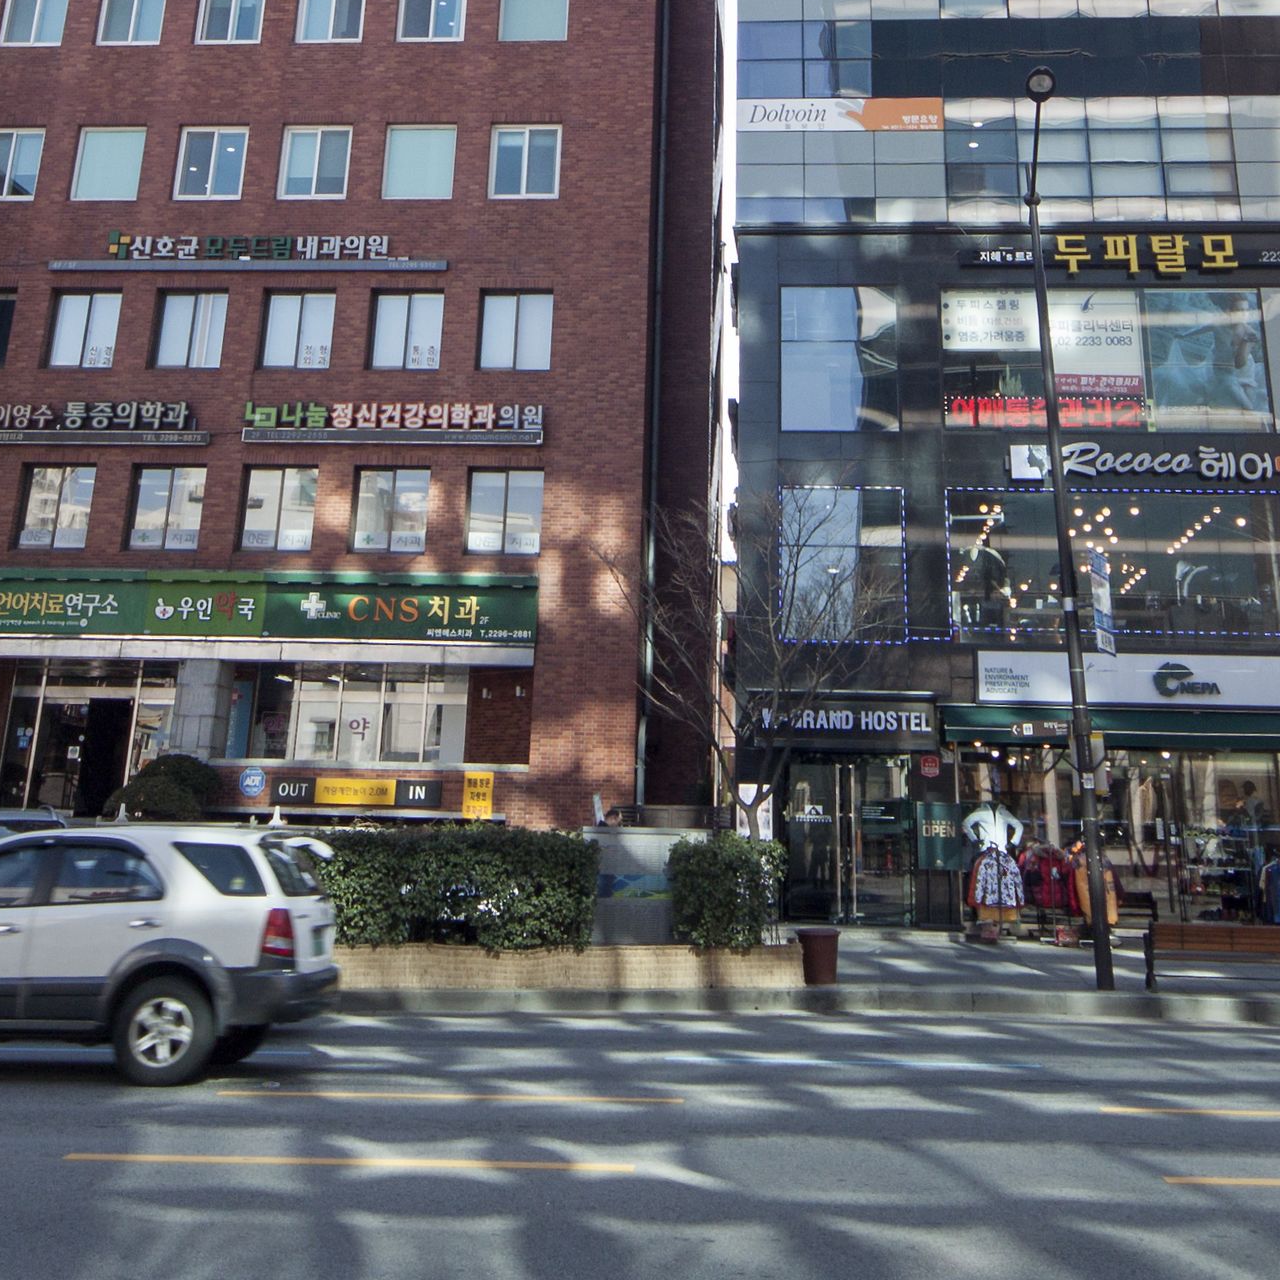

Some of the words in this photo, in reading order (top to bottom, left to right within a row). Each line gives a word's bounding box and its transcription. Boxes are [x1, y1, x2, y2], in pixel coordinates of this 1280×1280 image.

[749, 103, 827, 124] Dolvoin
[129, 235, 200, 260] 신호균
[203, 236, 293, 260] 모두드림
[296, 235, 389, 260] 내과의원
[1054, 234, 1238, 273] 두피탈모
[1075, 336, 1102, 347] 2233
[1106, 335, 1133, 346] 0083
[63, 401, 189, 430] 통증의학과
[1061, 441, 1193, 477] Rococo
[1199, 445, 1273, 480] 헤어
[177, 591, 256, 621] 우인약국
[317, 611, 341, 619] CLINIC
[348, 596, 418, 623] CNS
[427, 596, 481, 625] 치과
[479, 617, 490, 625] 2F
[1180, 681, 1221, 695] NEPA
[348, 717, 370, 742] 약
[861, 711, 932, 732] HOSTEL
[244, 776, 263, 787] ADT
[278, 783, 309, 797] OUT
[369, 786, 388, 797] 2.0M
[409, 785, 426, 800] IN
[923, 825, 956, 838] OPEN
